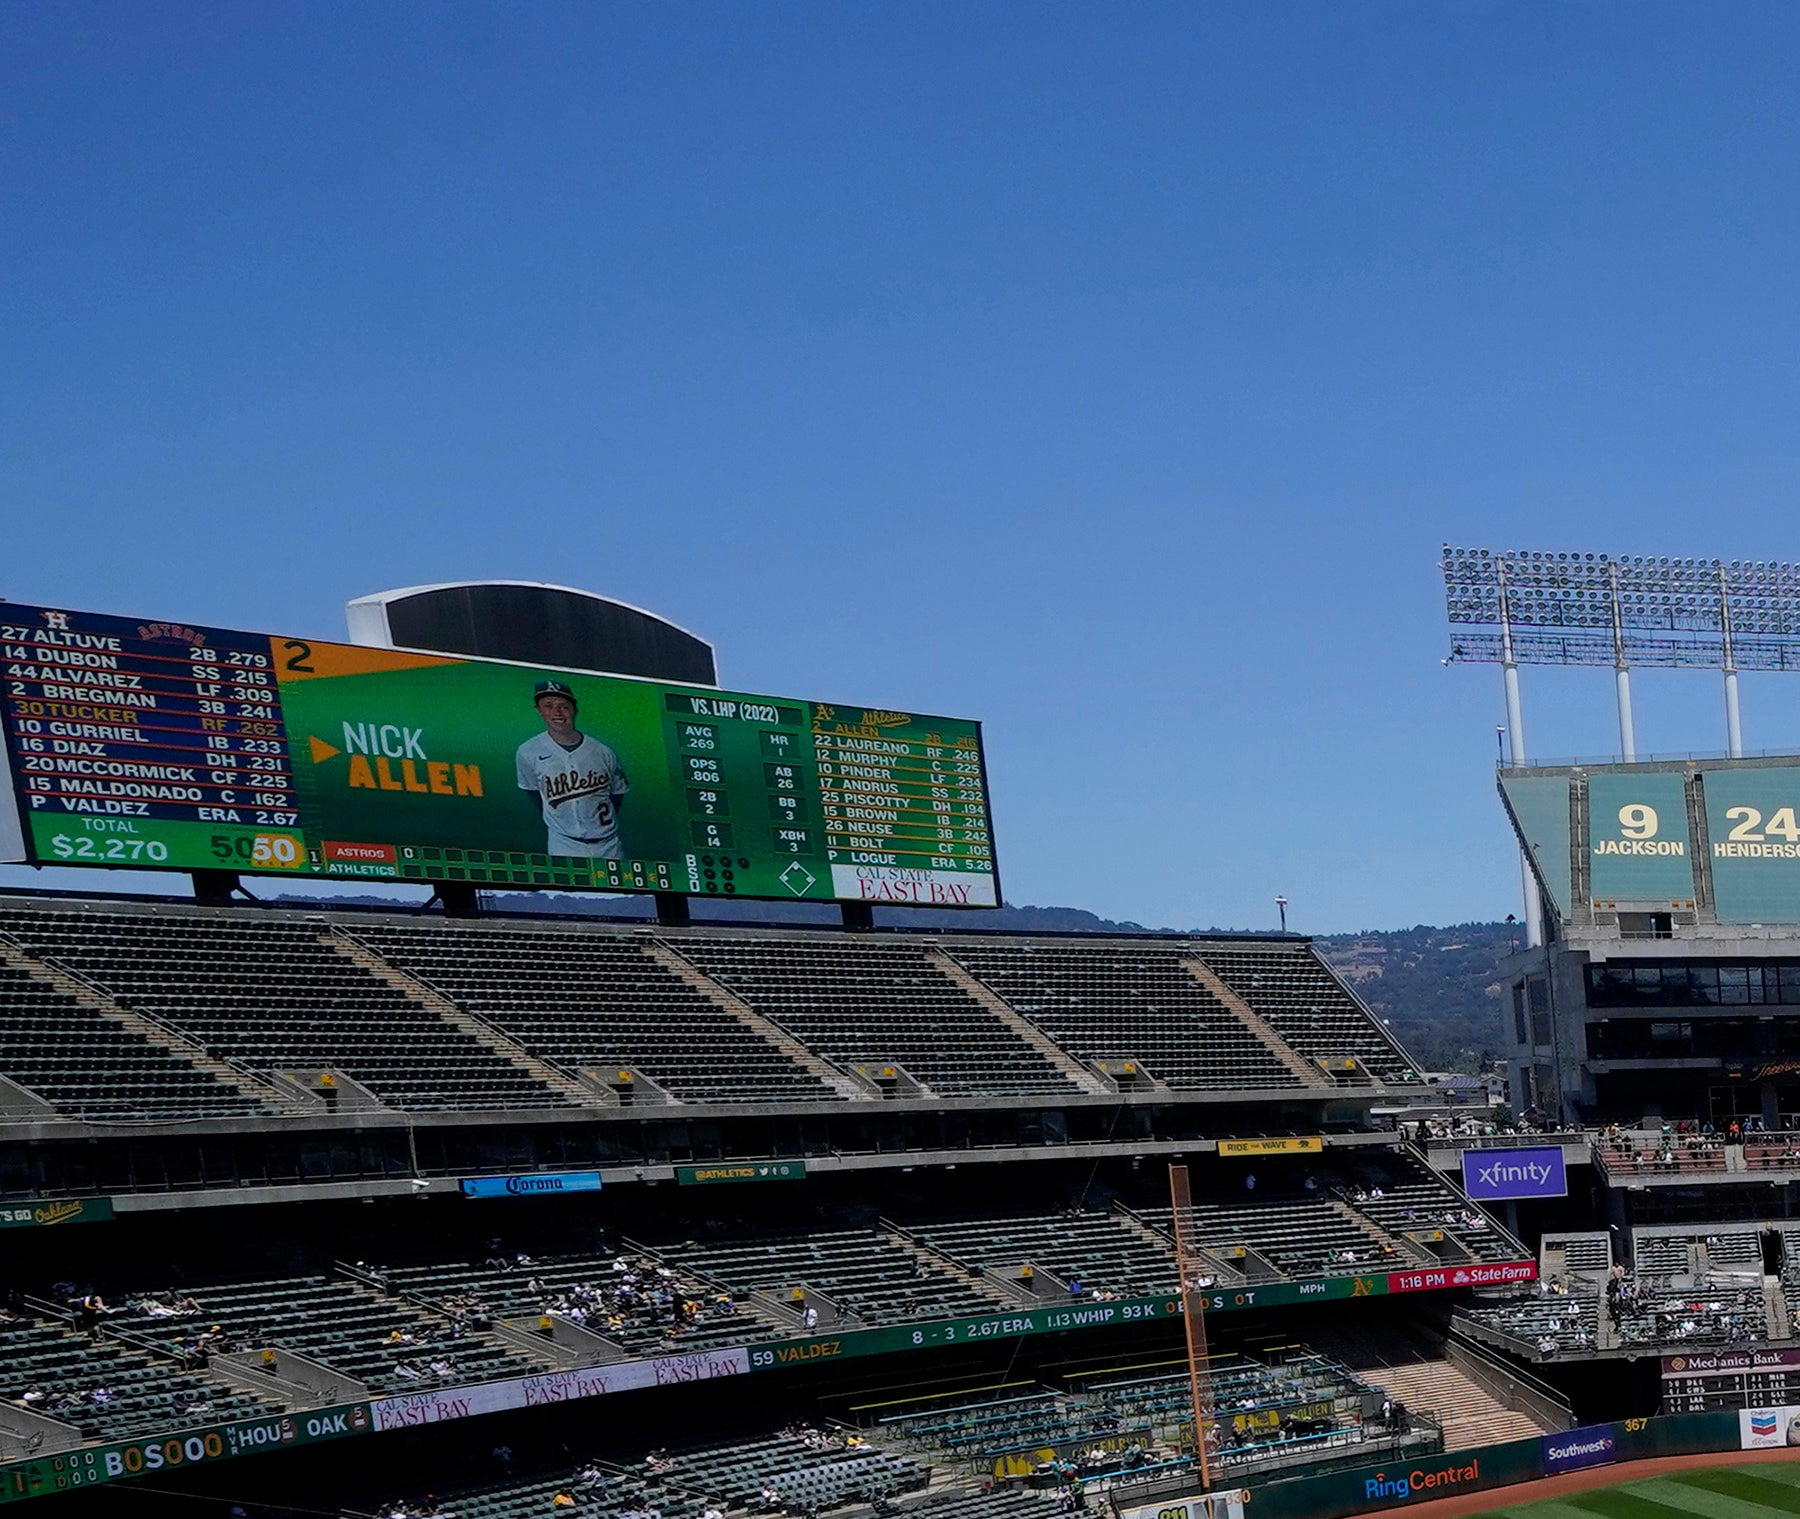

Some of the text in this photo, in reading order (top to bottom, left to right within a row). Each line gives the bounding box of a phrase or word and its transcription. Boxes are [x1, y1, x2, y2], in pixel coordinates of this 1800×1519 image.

[33, 628, 122, 651] ALTUVE
[37, 648, 118, 670] DUBON
[283, 641, 315, 673] 2
[40, 666, 143, 689] ALVAREZ
[43, 684, 156, 708] BREGMAN
[47, 702, 138, 724] TUCKER
[713, 700, 780, 725] LHP (2022)
[50, 720, 149, 743] GURRIEL
[342, 720, 427, 760] NICK
[53, 740, 107, 757] DIAZ
[837, 737, 910, 755] LAUREANO
[57, 758, 196, 782] MCCORMICK
[839, 751, 898, 767] MURPHY
[349, 754, 484, 797] ALLEN
[840, 765, 891, 779] PINDER
[60, 778, 203, 801] MALDONADO
[843, 780, 899, 794] ANDRUS
[60, 796, 150, 816] VALDEZ
[844, 793, 910, 809] PISCOTTY
[846, 807, 898, 821] BROWN
[1617, 803, 1660, 839] 9
[848, 821, 894, 835] NEUSE
[52, 833, 168, 862] $2,270
[850, 836, 884, 849] BOLT
[1594, 840, 1685, 857] JACKSON
[851, 852, 897, 865] LOGUE
[856, 867, 934, 882] CAL STATE
[858, 878, 972, 905] EAST BAY
[1227, 1140, 1287, 1151] RIDE WAVE
[1478, 1160, 1552, 1186] xfinity
[505, 1174, 563, 1195] Corona
[1426, 1273, 1446, 1287] PM
[967, 1321, 999, 1338] 2.67
[1002, 1317, 1034, 1334] ERA
[1074, 1308, 1115, 1325] WHIP
[752, 1341, 841, 1367] 59 VALDEZ
[1688, 1355, 1751, 1370] Mechanics
[1753, 1352, 1782, 1365] Bank
[524, 1377, 609, 1406] EAST BAY
[379, 1398, 473, 1431] EAST BAY
[1624, 1418, 1649, 1432] 367
[239, 1424, 281, 1448] HOU
[307, 1414, 348, 1438] OAK
[1548, 1439, 1606, 1461] Southwest
[1364, 1458, 1480, 1499] RingCentral
